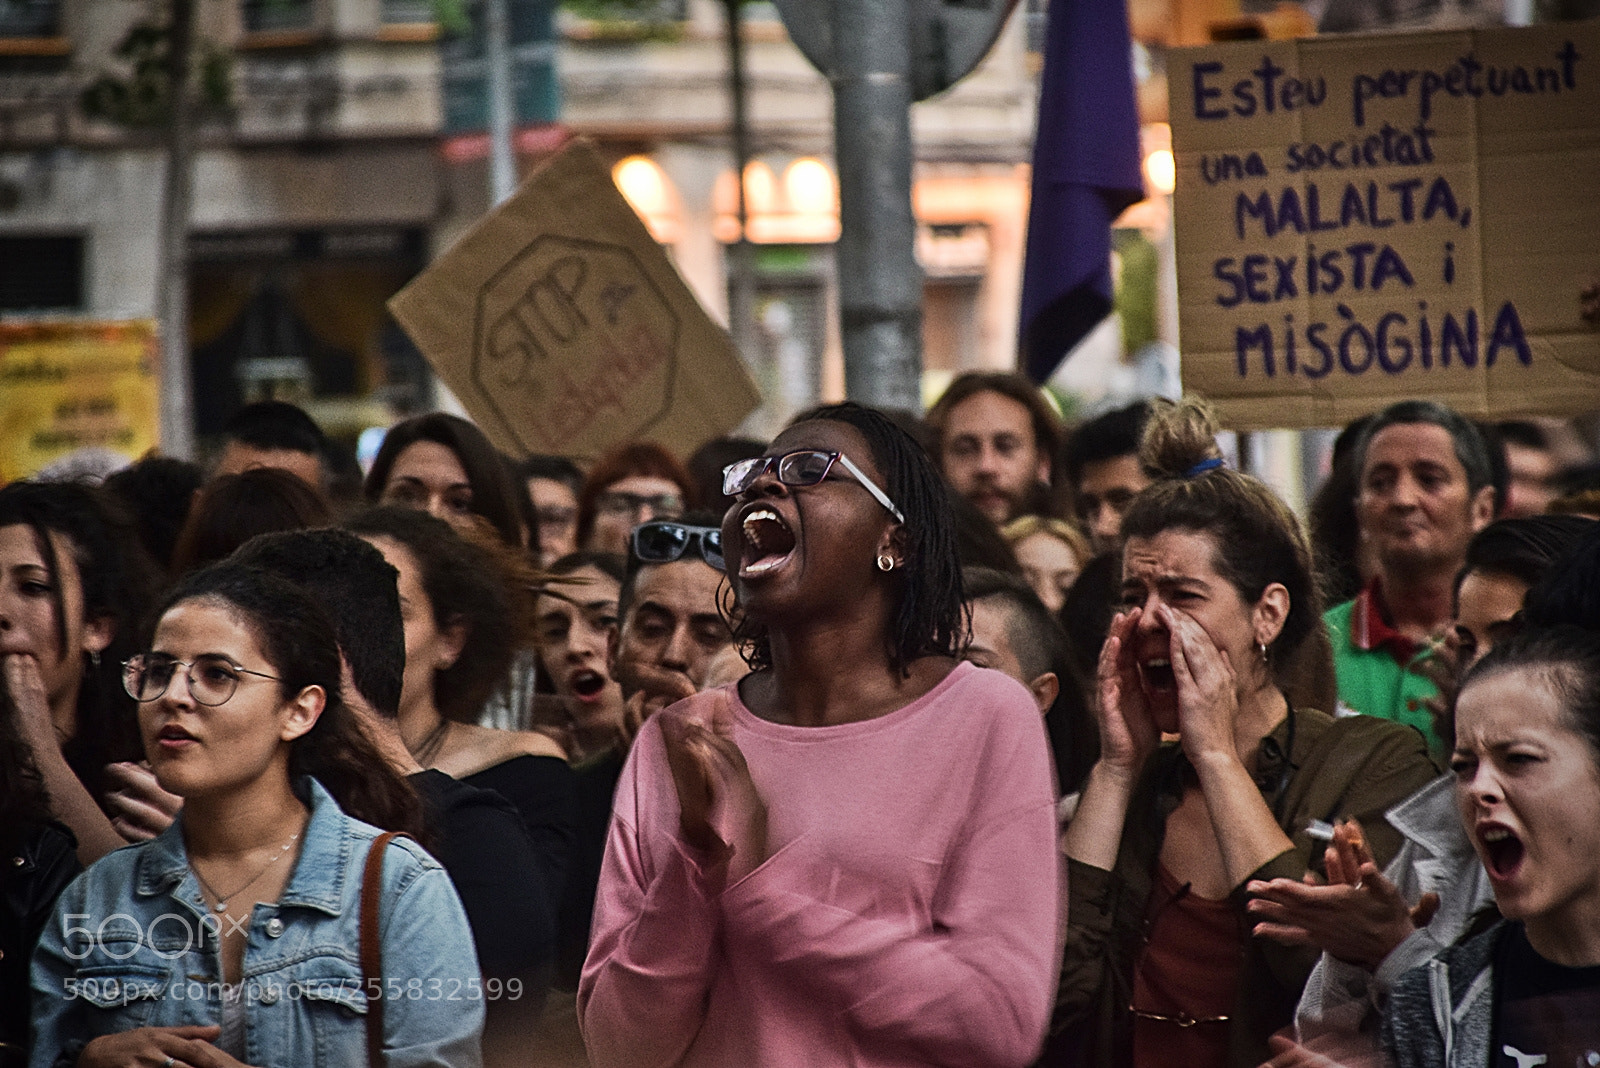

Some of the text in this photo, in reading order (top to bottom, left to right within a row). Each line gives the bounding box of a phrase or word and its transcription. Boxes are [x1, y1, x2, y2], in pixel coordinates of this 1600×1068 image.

[1191, 41, 1580, 127] Esteu perpetuant
[1202, 123, 1436, 185] una societat
[1235, 176, 1472, 240] MALALTA,
[1443, 242, 1455, 284] i
[486, 255, 590, 388] STOP
